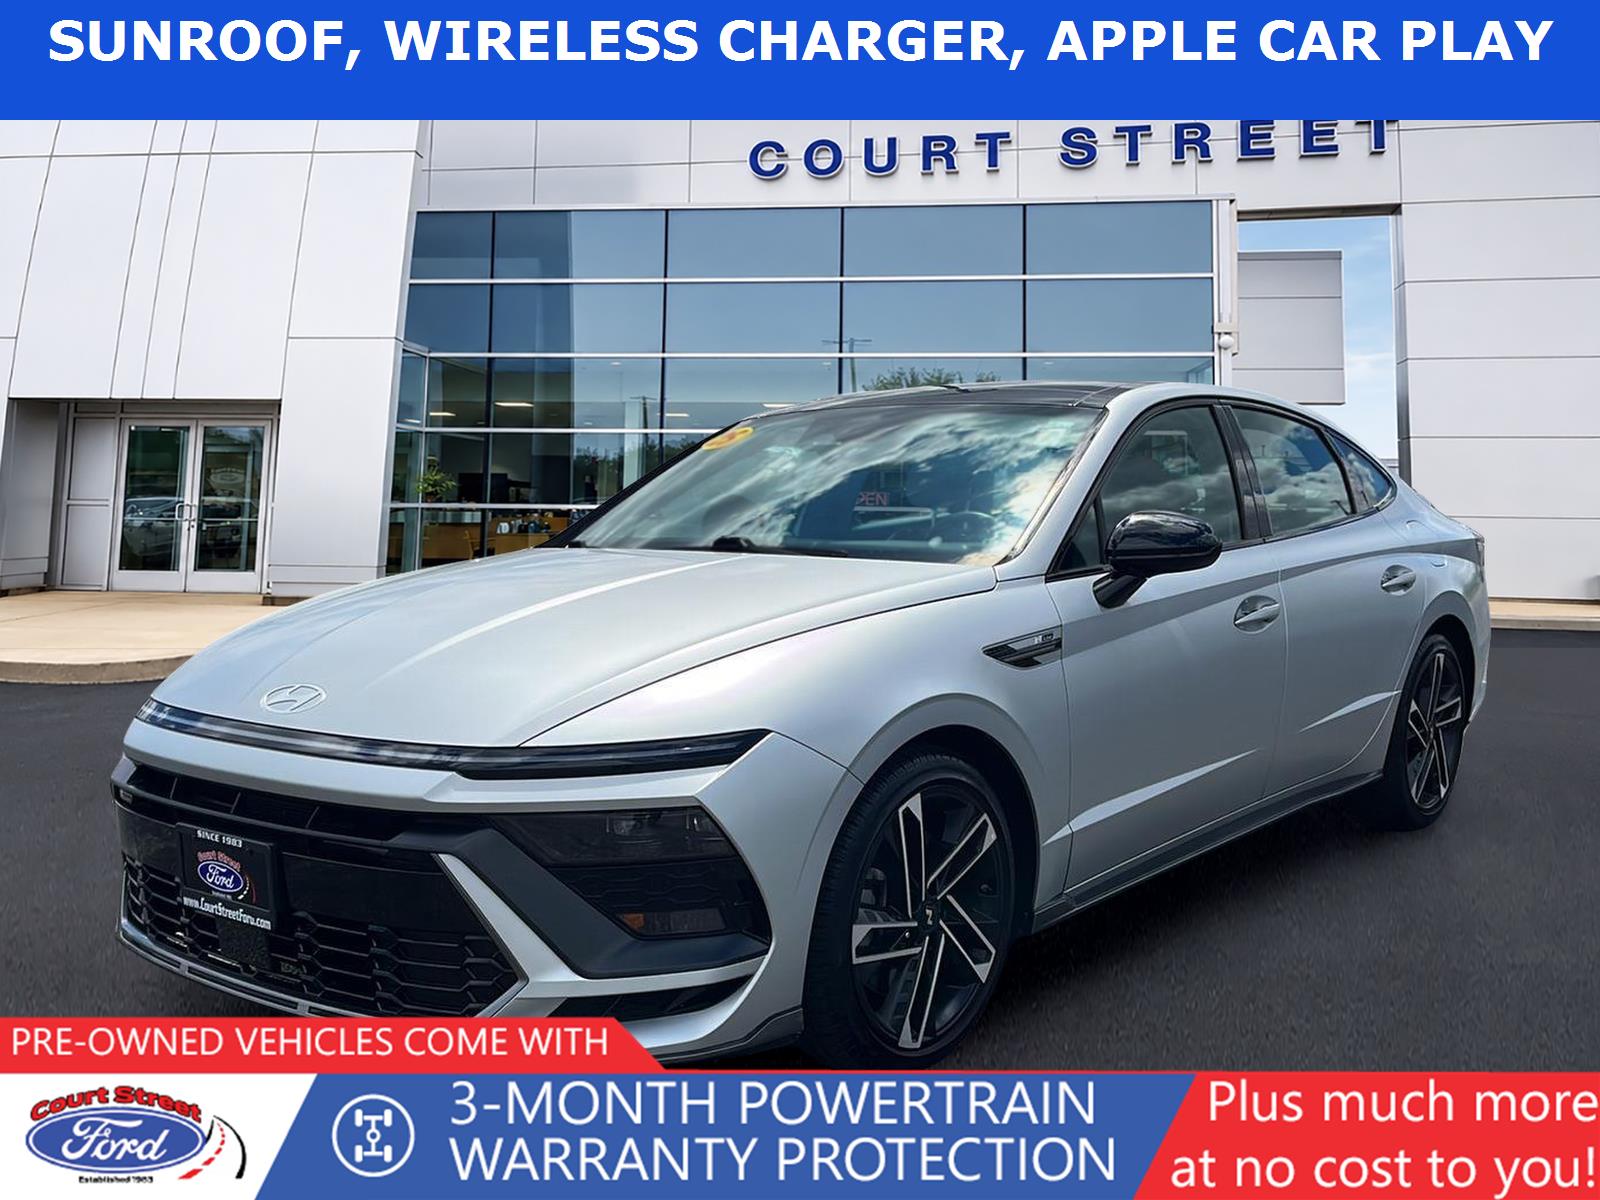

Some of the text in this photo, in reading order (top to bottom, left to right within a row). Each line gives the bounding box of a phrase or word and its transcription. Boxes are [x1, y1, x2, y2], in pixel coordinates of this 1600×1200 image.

[748, 119, 1400, 179] COURT STREET
[196, 829, 220, 843] SINCE
[206, 864, 235, 889] Ford
